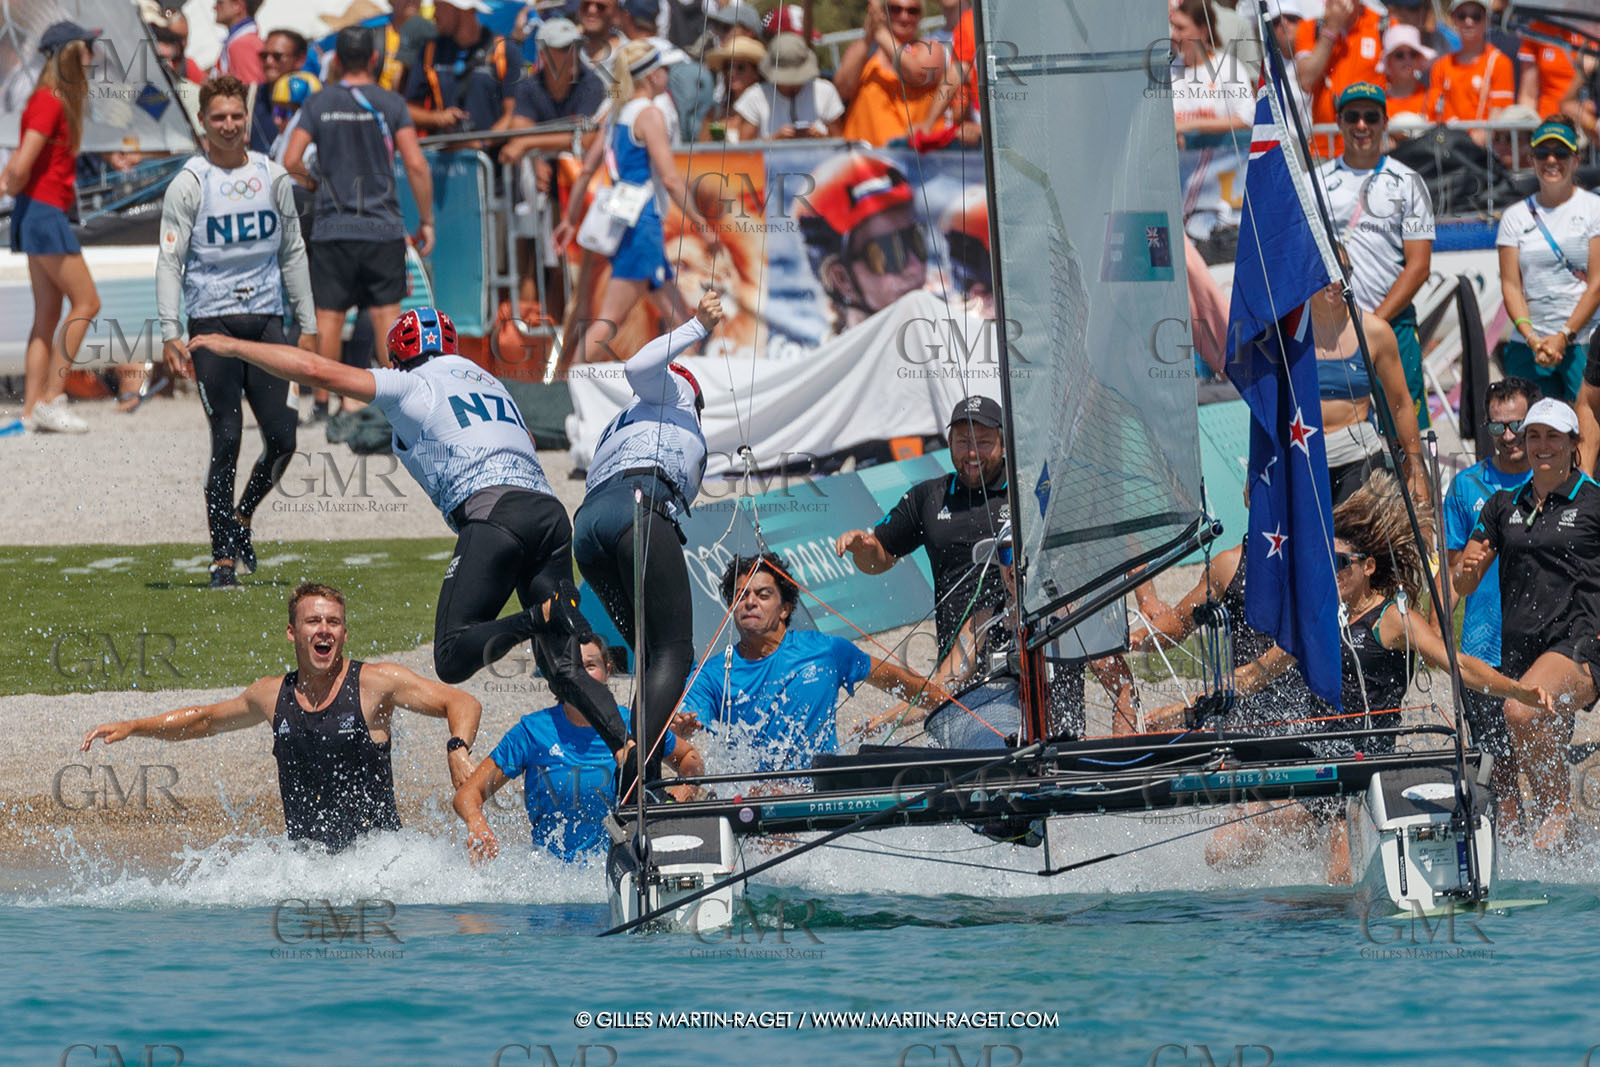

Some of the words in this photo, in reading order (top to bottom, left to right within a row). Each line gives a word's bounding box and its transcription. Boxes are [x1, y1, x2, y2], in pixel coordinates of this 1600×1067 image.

[207, 210, 278, 244] NED
[1219, 773, 1254, 785] PARIS
[809, 800, 844, 813] PARIS
[848, 799, 880, 811] 2024
